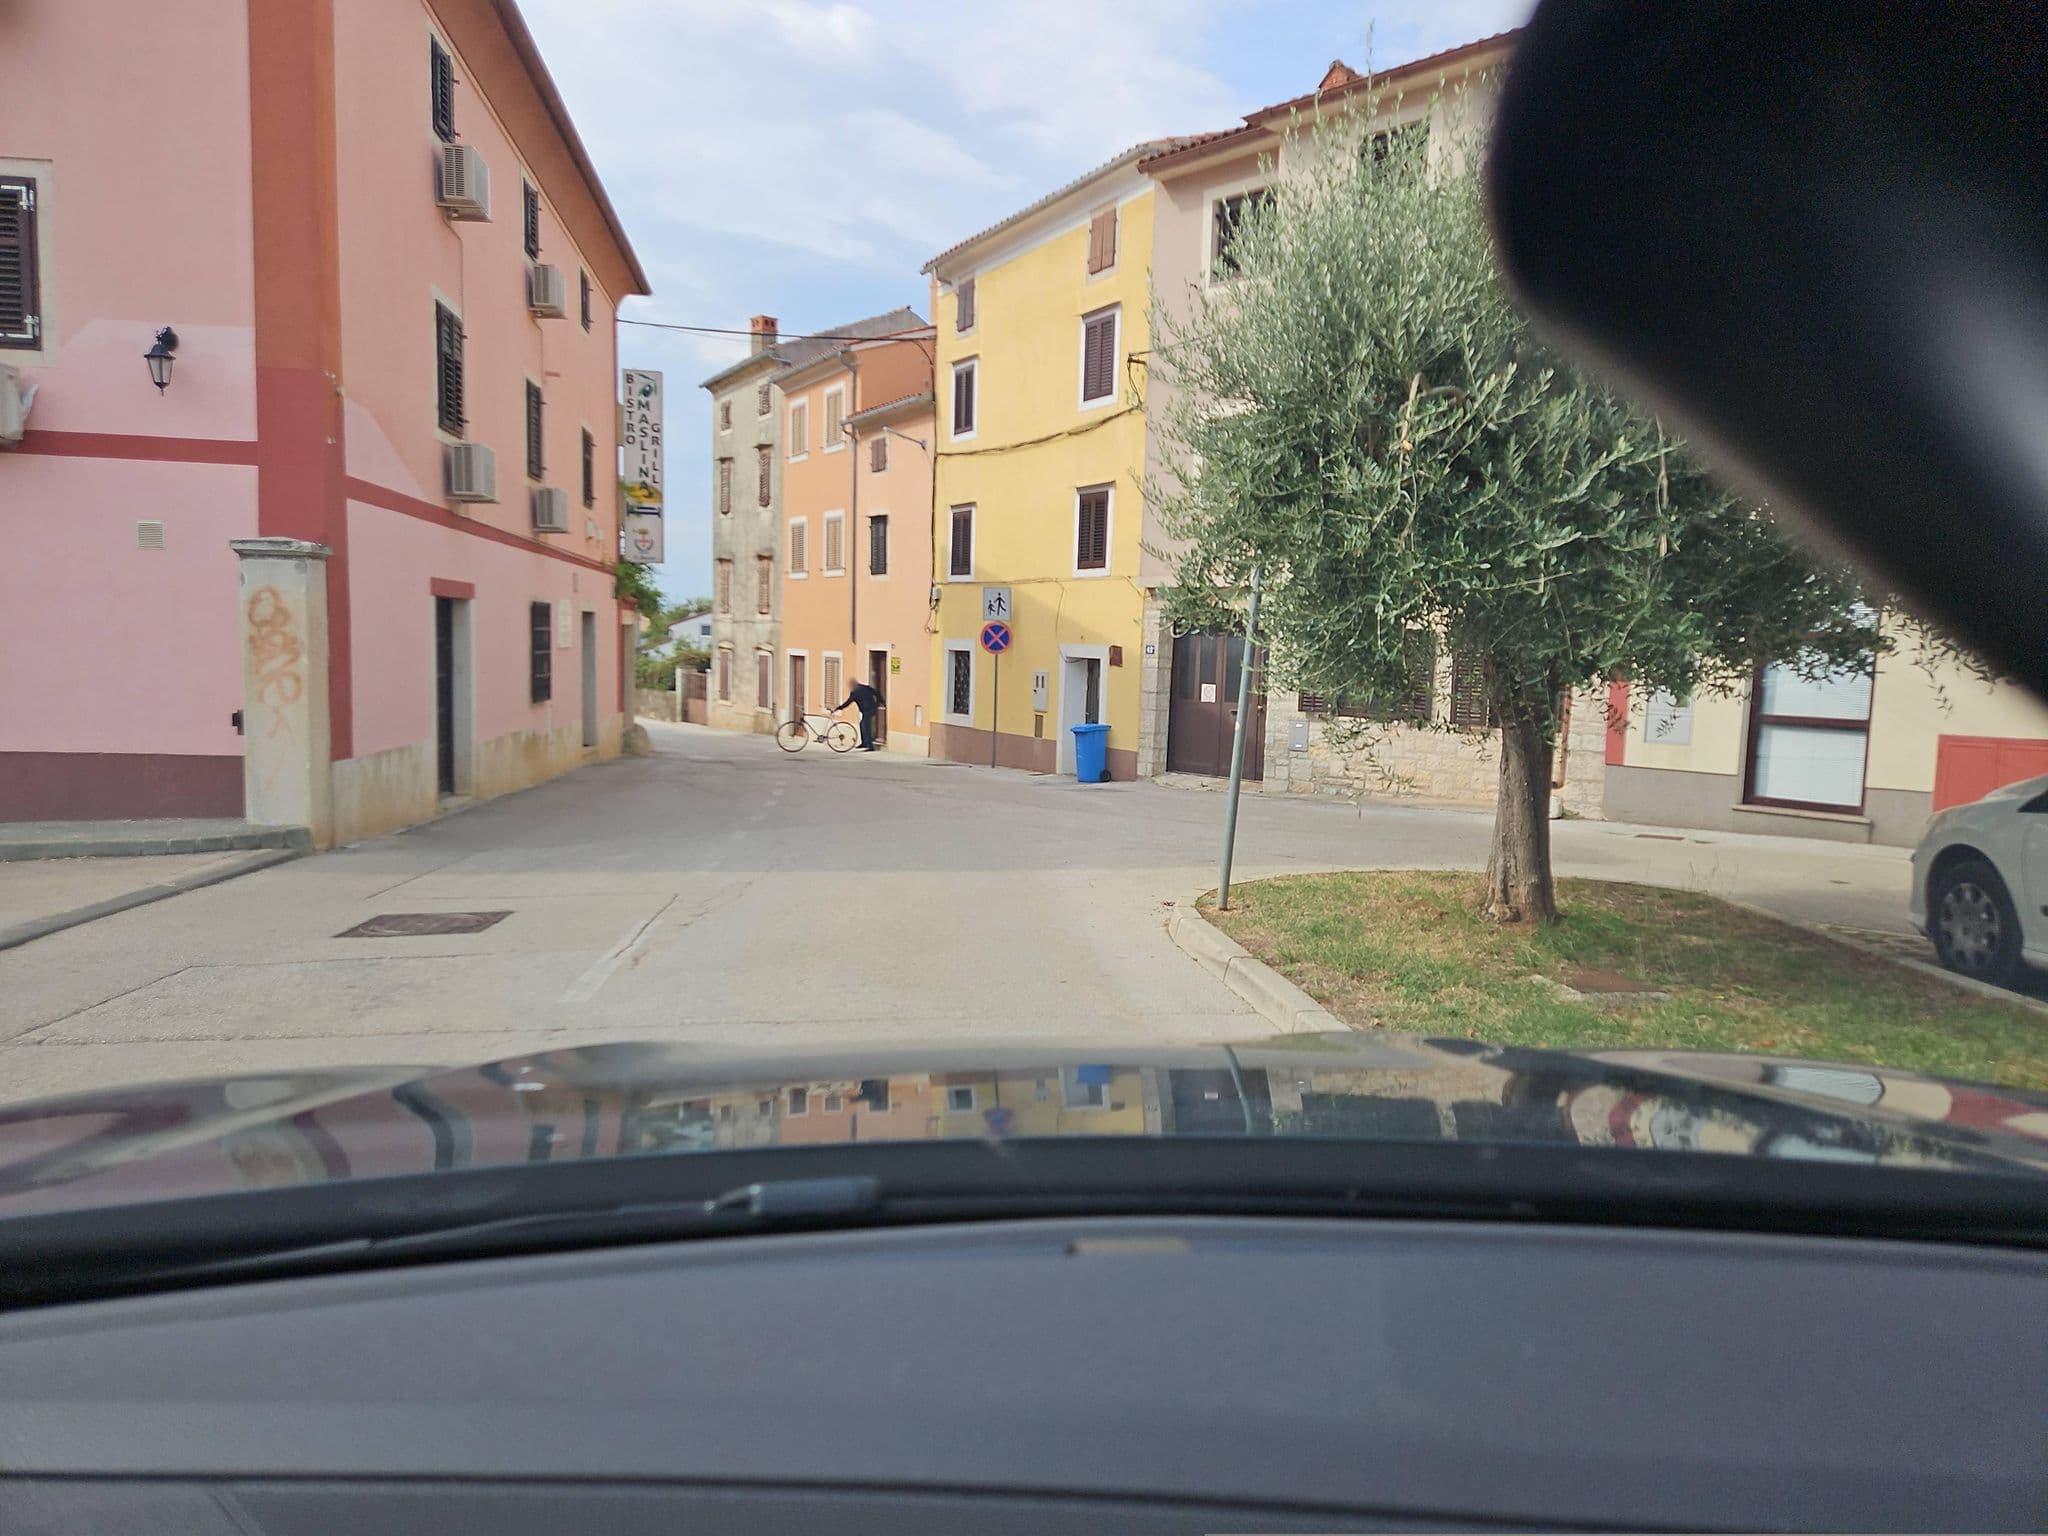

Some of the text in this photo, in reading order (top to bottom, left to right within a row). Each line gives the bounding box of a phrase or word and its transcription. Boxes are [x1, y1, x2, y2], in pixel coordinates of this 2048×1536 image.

[625, 374, 636, 445] BISTRO
[638, 399, 651, 492] MASLINA
[651, 423, 661, 484] GRILL
